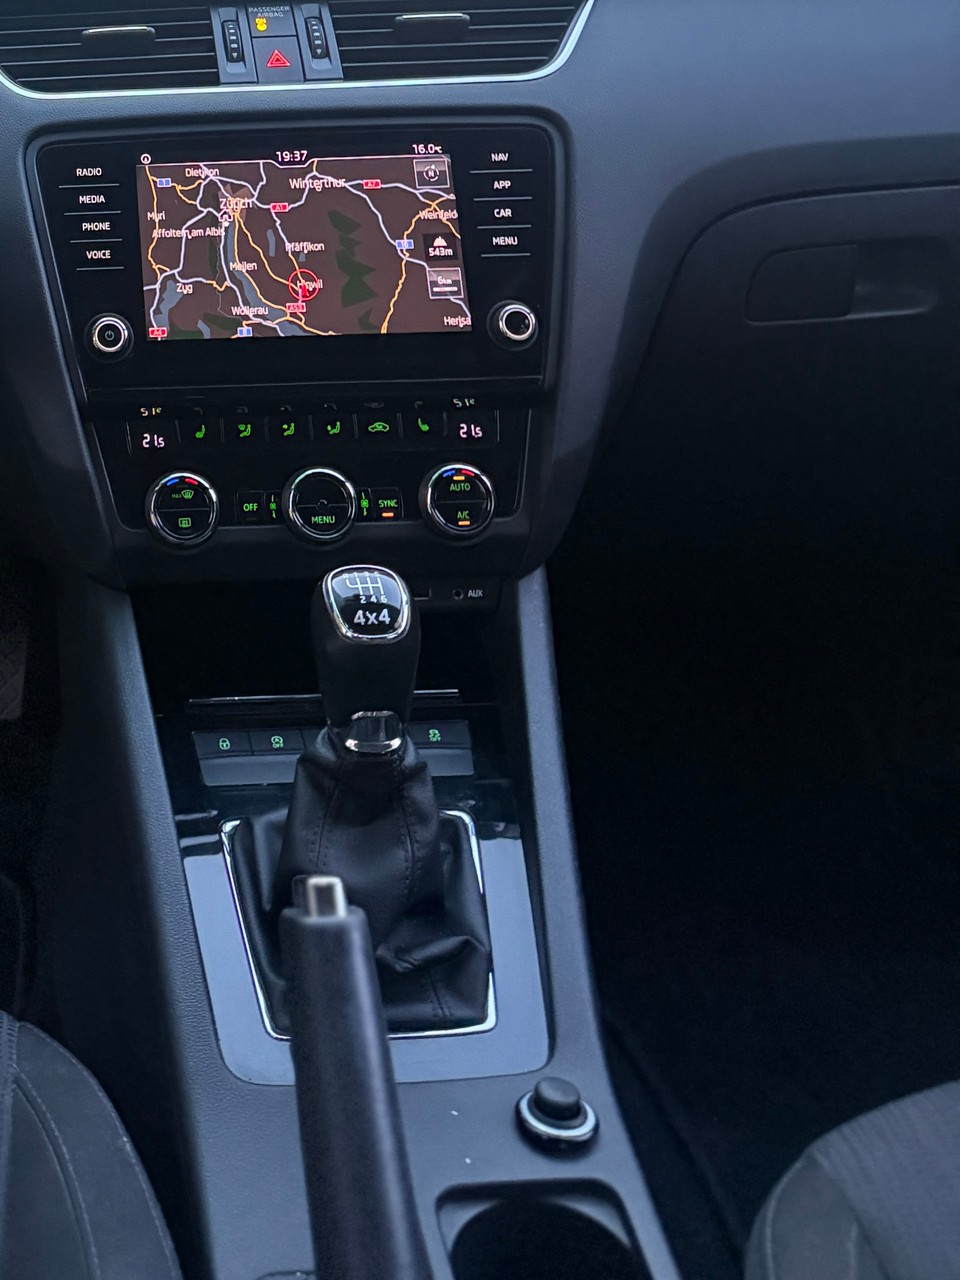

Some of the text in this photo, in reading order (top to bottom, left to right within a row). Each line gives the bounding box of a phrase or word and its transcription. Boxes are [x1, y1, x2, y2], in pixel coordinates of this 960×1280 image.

[275, 150, 308, 162] 19:37
[490, 152, 509, 162] NAV
[76, 167, 103, 177] RADIO
[289, 178, 346, 190] Winterthur
[493, 180, 511, 190] APP
[79, 195, 106, 204] MEDIA
[493, 208, 512, 218] CAR
[82, 221, 111, 231] PHONE
[205, 227, 225, 237] Albis
[492, 236, 518, 246] MENU
[86, 250, 111, 259] VOICE
[428, 247, 453, 257] 543m
[176, 283, 193, 294] Zug
[449, 482, 471, 492] AUTO
[243, 502, 259, 512] OFF
[378, 499, 398, 508] SYNC
[311, 515, 336, 524] MENU
[456, 510, 470, 520] A/C
[467, 589, 483, 598] AUX
[359, 595, 388, 604] 2 4 6
[353, 608, 391, 626] 4x4
